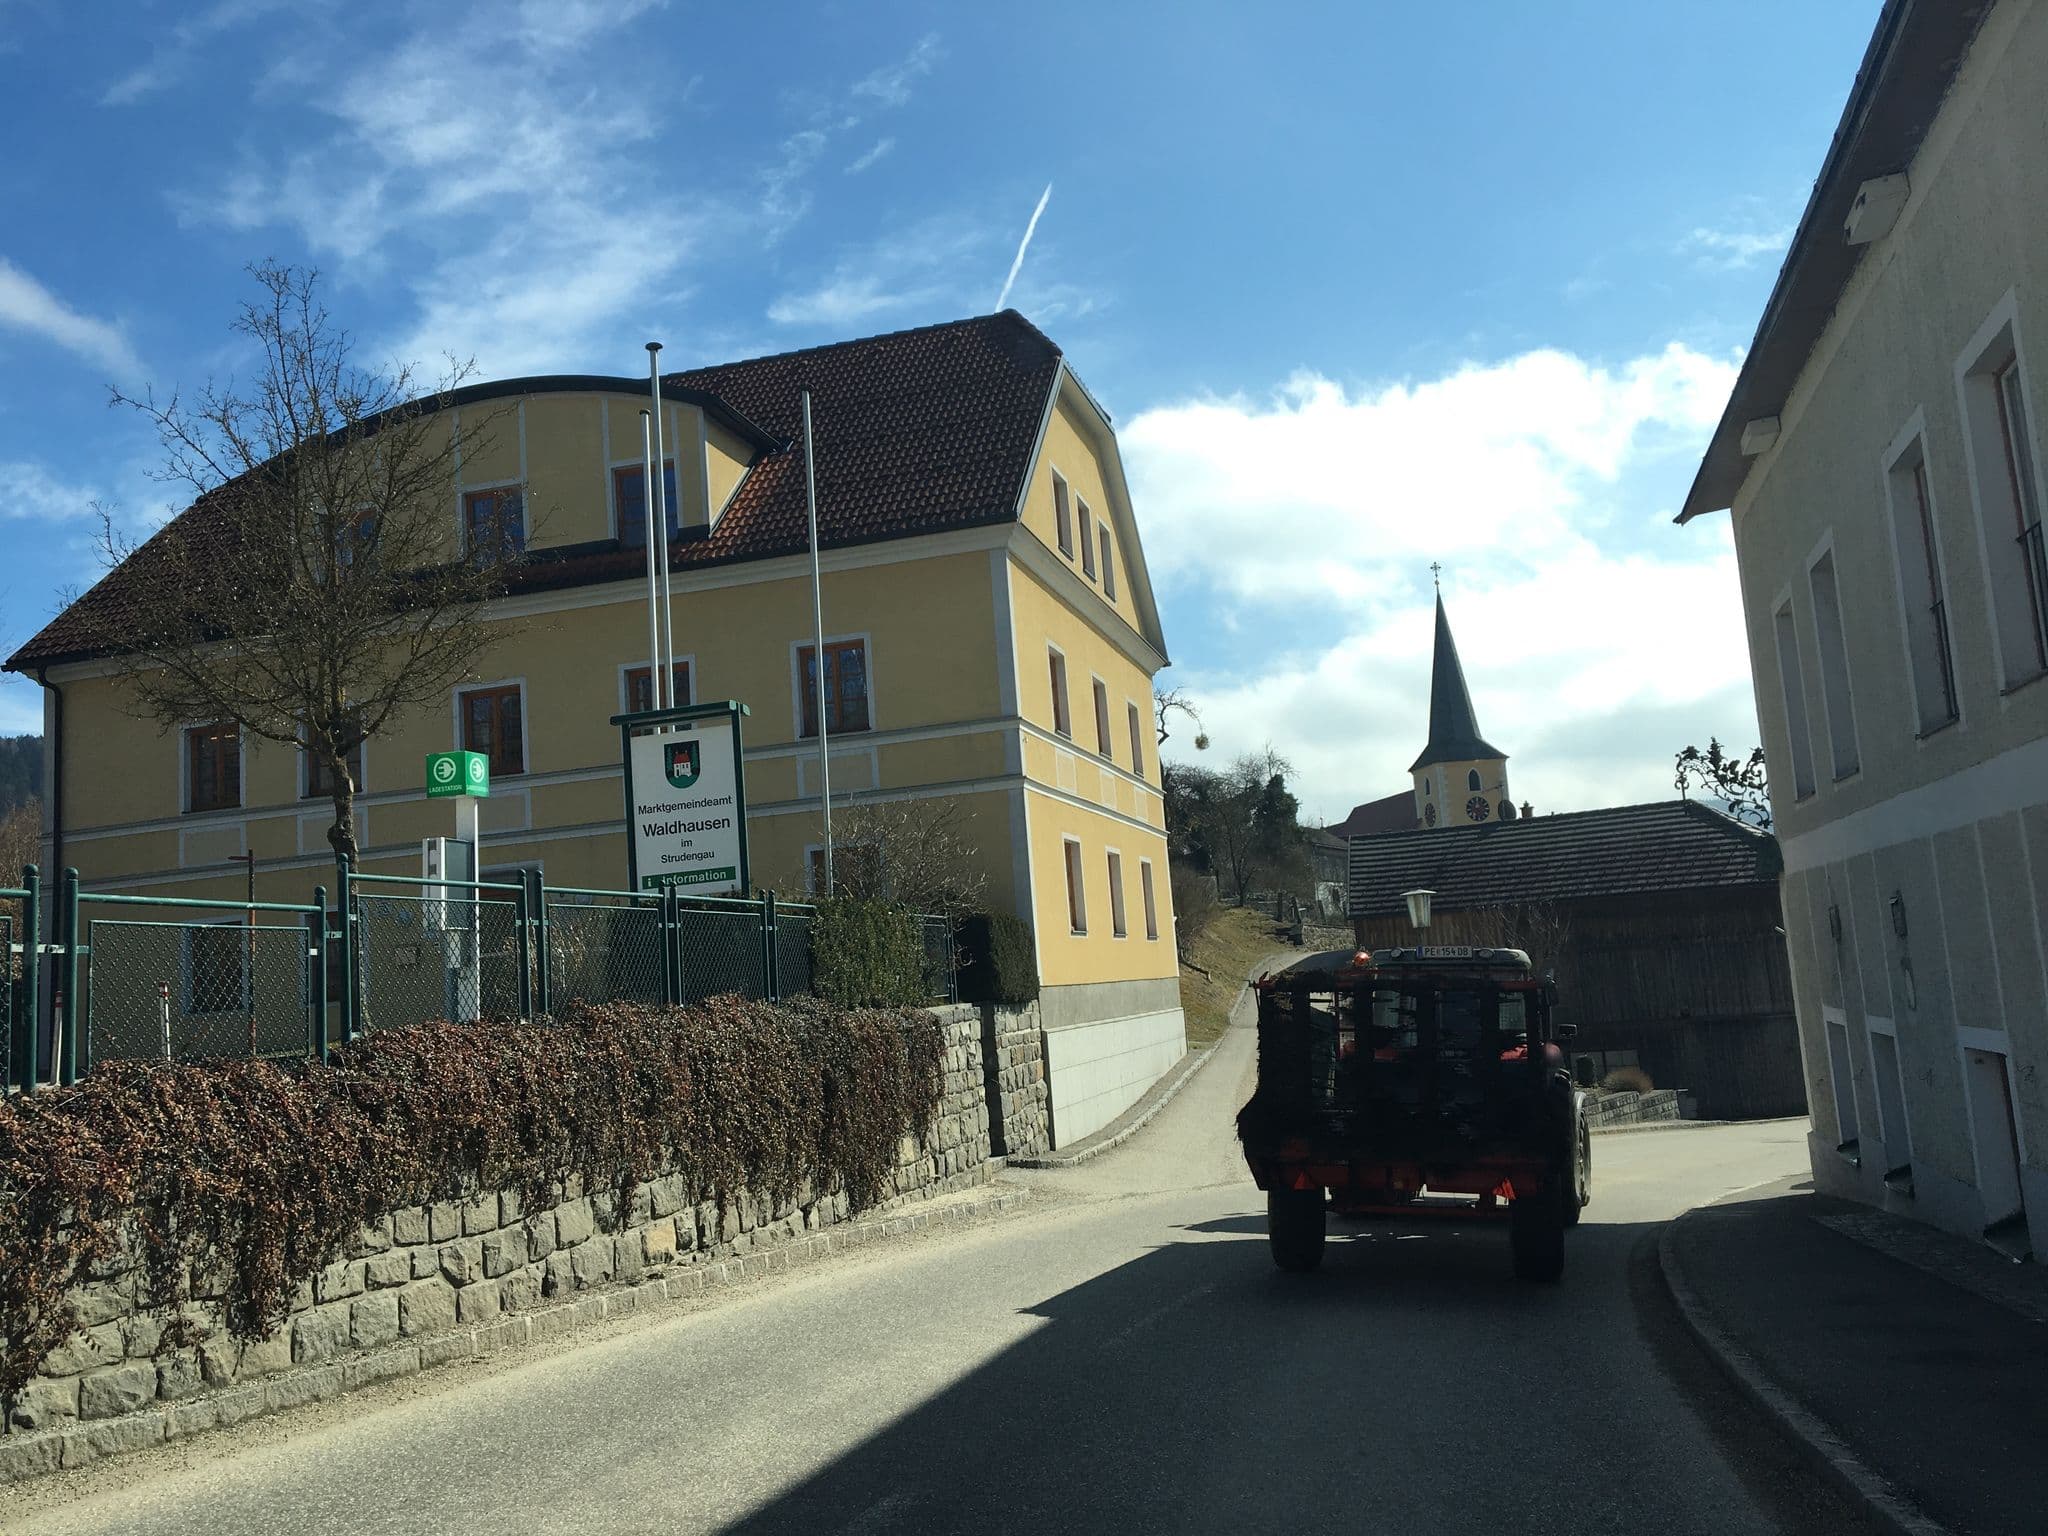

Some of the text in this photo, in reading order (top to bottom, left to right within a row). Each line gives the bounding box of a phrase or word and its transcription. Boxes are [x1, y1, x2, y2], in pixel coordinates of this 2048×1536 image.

[637, 795, 733, 816] Marktgemeindeamt
[642, 816, 731, 838] Waldhausen
[680, 838, 693, 848] im
[661, 850, 715, 864] Strudengau
